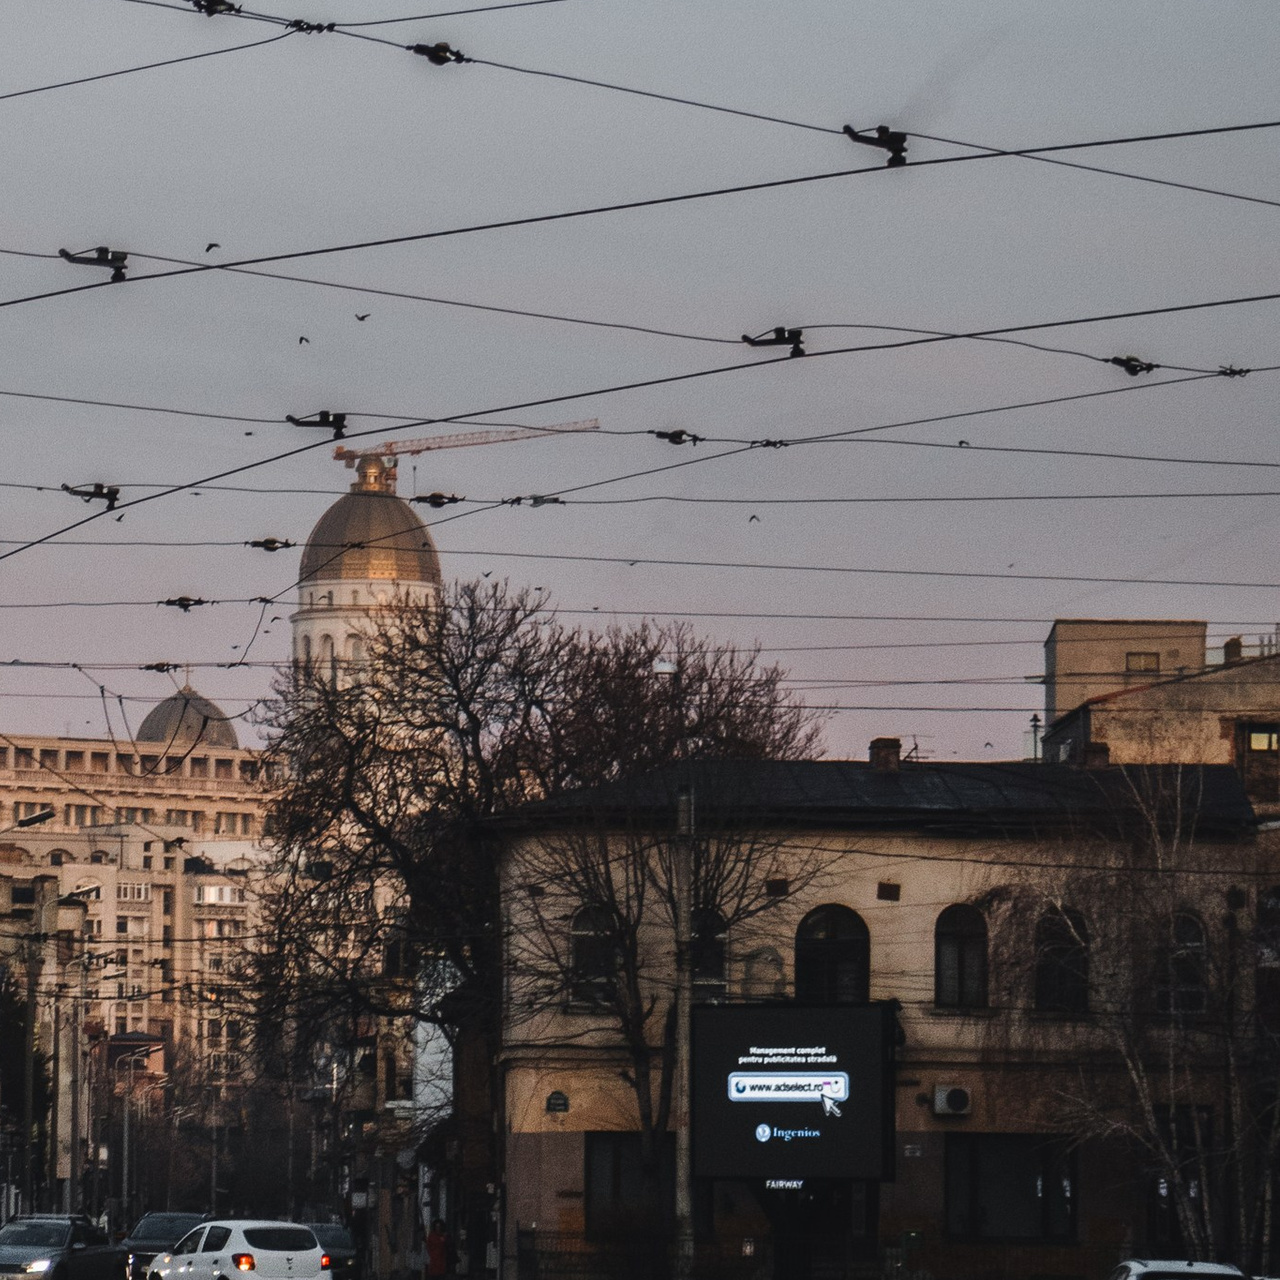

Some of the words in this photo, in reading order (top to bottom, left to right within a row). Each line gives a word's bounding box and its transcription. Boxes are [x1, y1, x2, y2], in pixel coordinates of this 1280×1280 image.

[749, 1046, 795, 1056] Management
[796, 1046, 826, 1055] complet
[738, 1056, 763, 1064] pentru
[763, 1055, 806, 1064] publicitatea
[749, 1081, 824, 1092] www.adselect.ro
[773, 1127, 821, 1141] Ingenios
[766, 1180, 804, 1189] FAIRWAY
